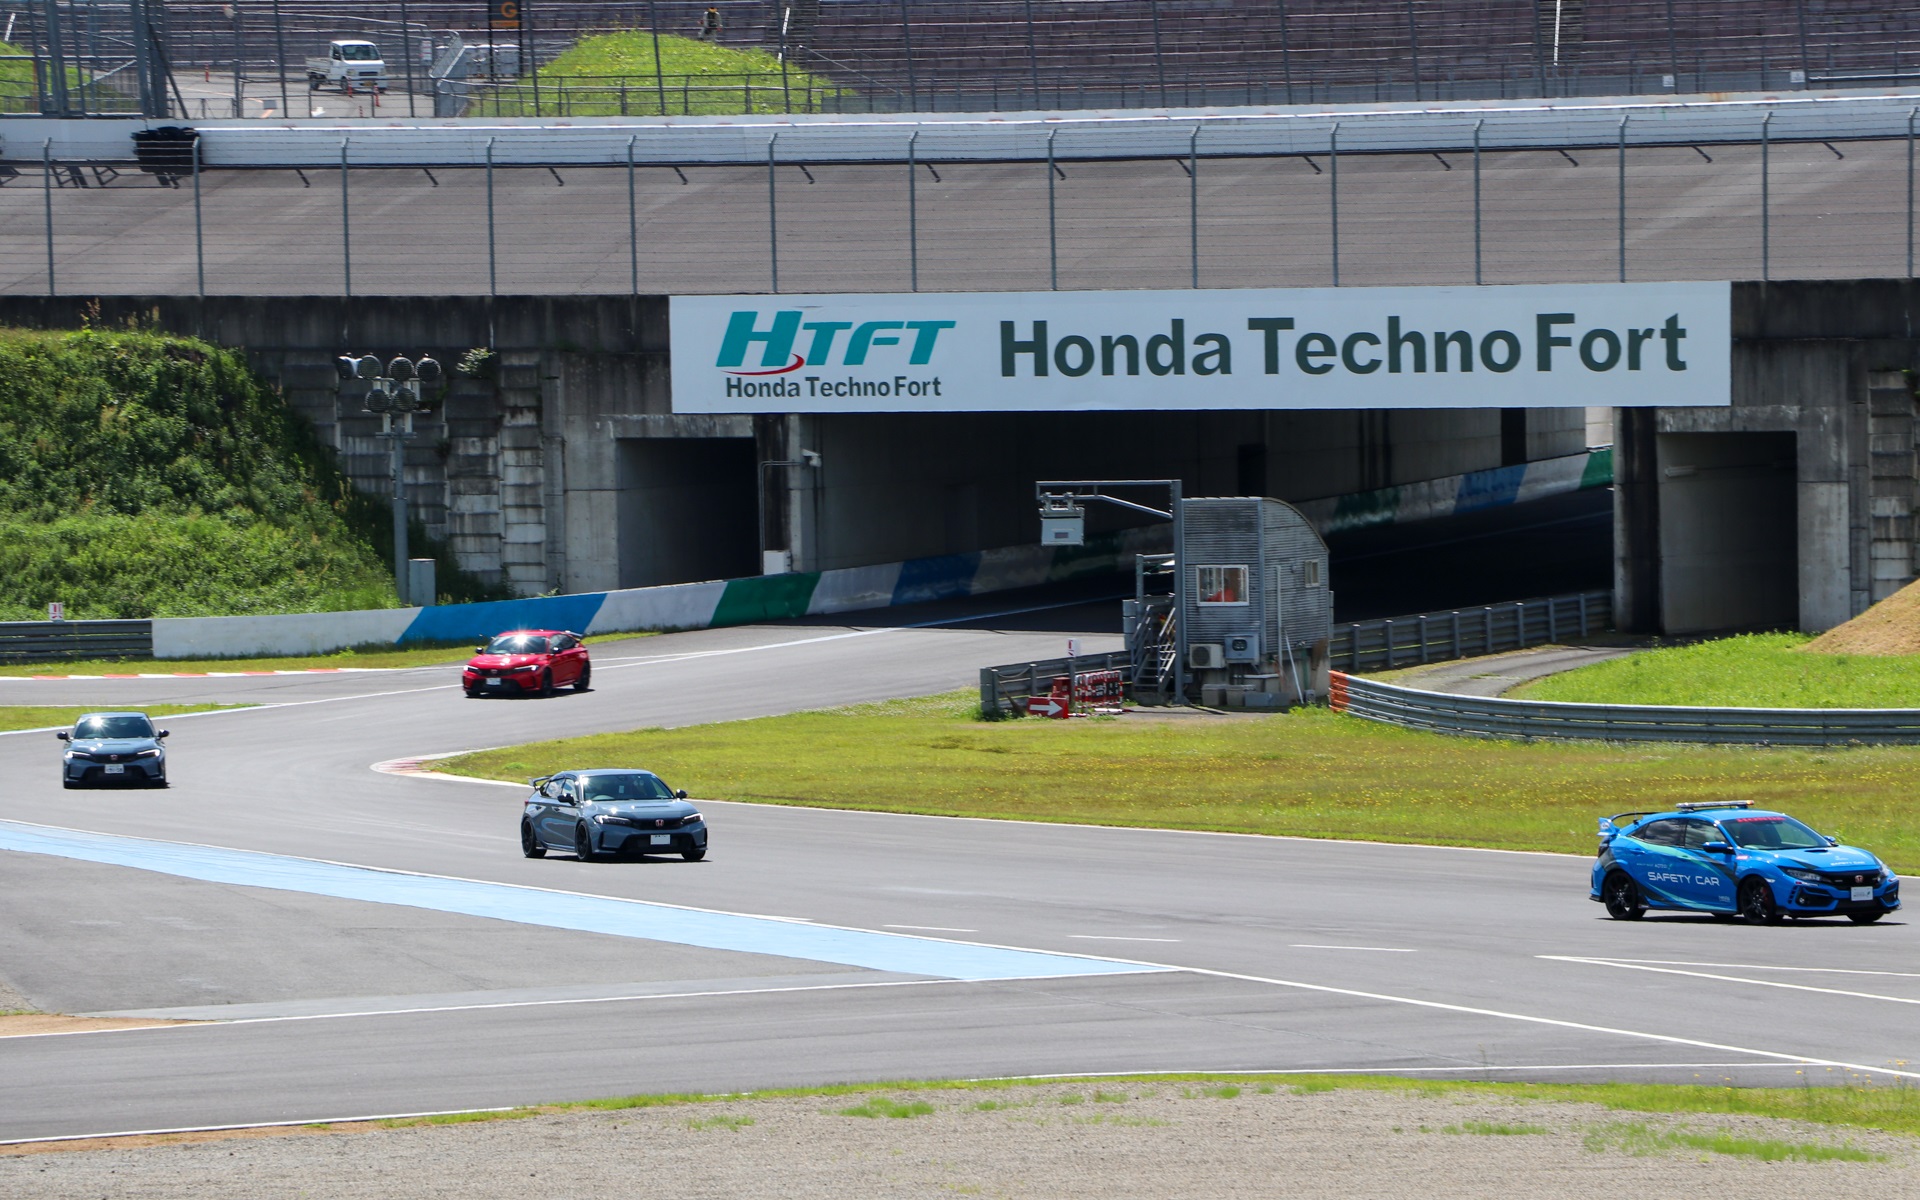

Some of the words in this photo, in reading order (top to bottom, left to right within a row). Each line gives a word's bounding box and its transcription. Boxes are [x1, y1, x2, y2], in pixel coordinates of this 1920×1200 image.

[501, 2, 517, 18] G
[716, 311, 956, 367] HTFT
[1001, 318, 1232, 377] Honda
[1248, 315, 1522, 374] Techno
[1536, 313, 1687, 372] Fort
[726, 377, 800, 398] Honda
[805, 376, 890, 397] Techno
[895, 376, 941, 396] Fort
[1647, 871, 1691, 884] SAFETY
[1695, 875, 1720, 887] CAR
